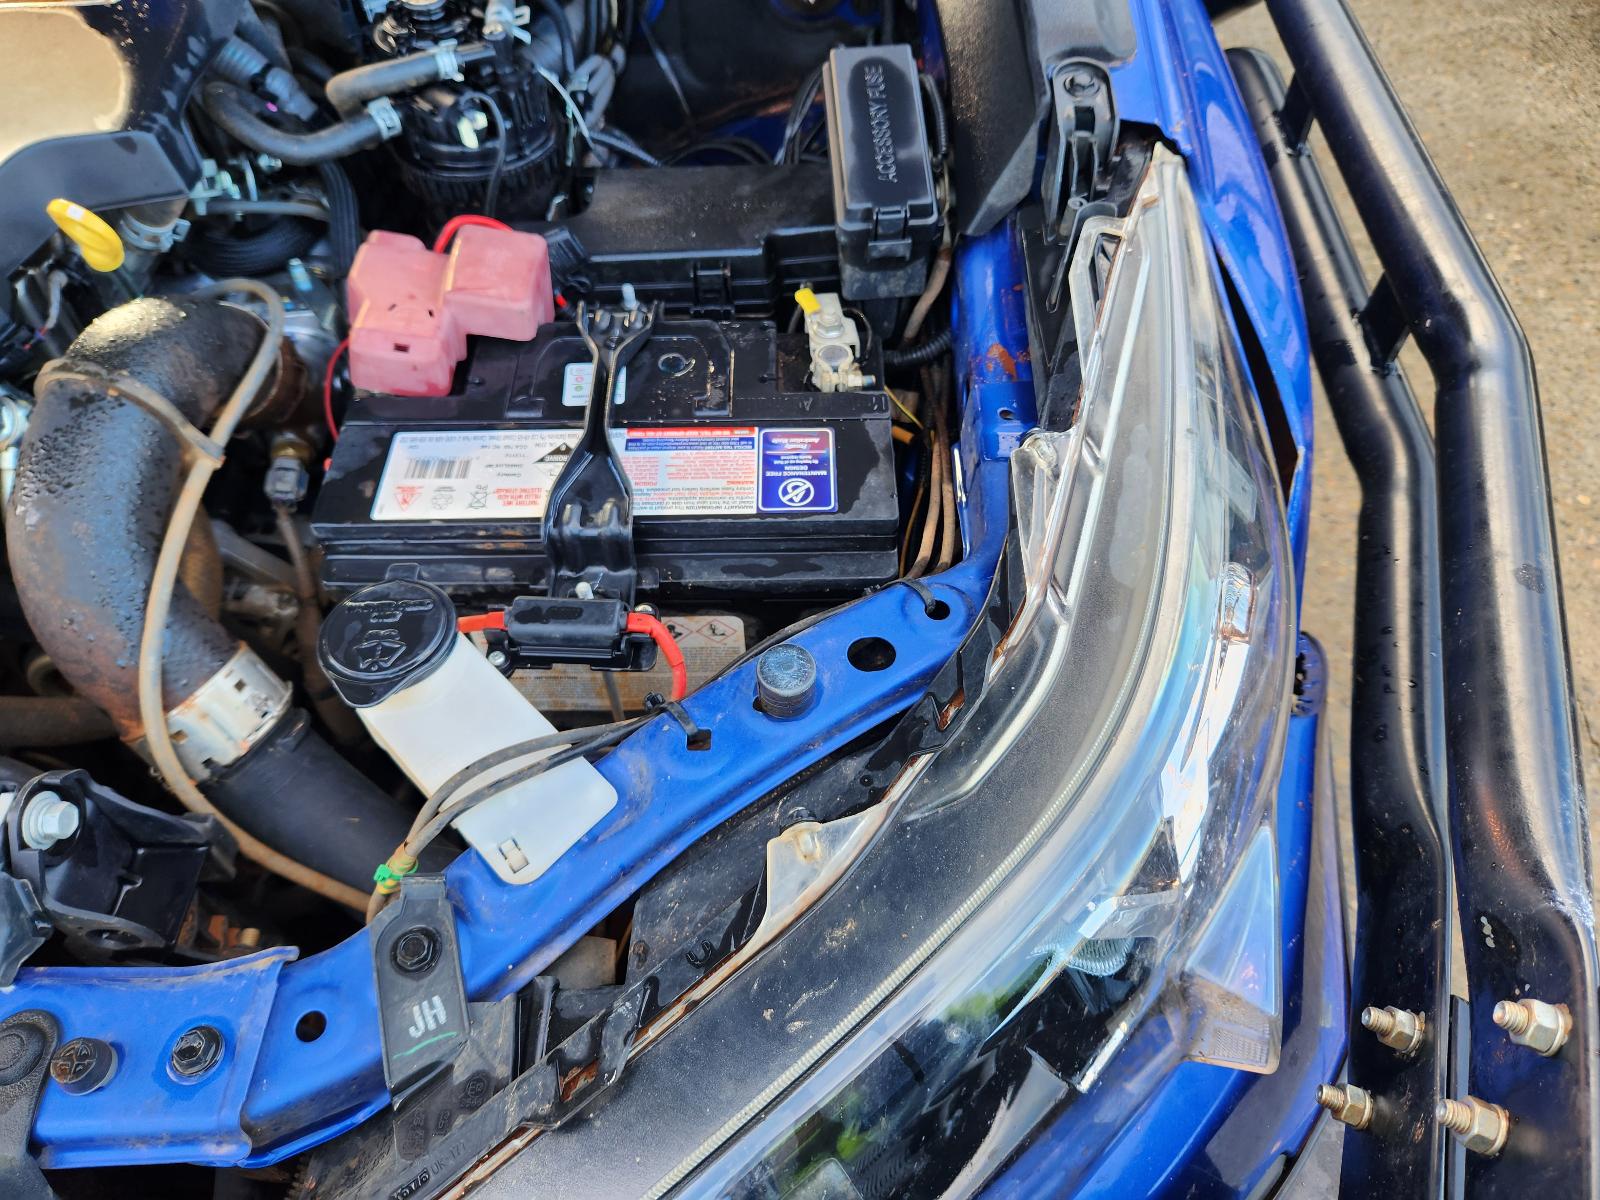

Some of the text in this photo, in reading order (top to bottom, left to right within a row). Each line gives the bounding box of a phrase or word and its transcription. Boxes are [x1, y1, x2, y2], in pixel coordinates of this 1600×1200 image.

[863, 64, 898, 183] ACCESSORY FUSE
[409, 995, 447, 1038] JH
